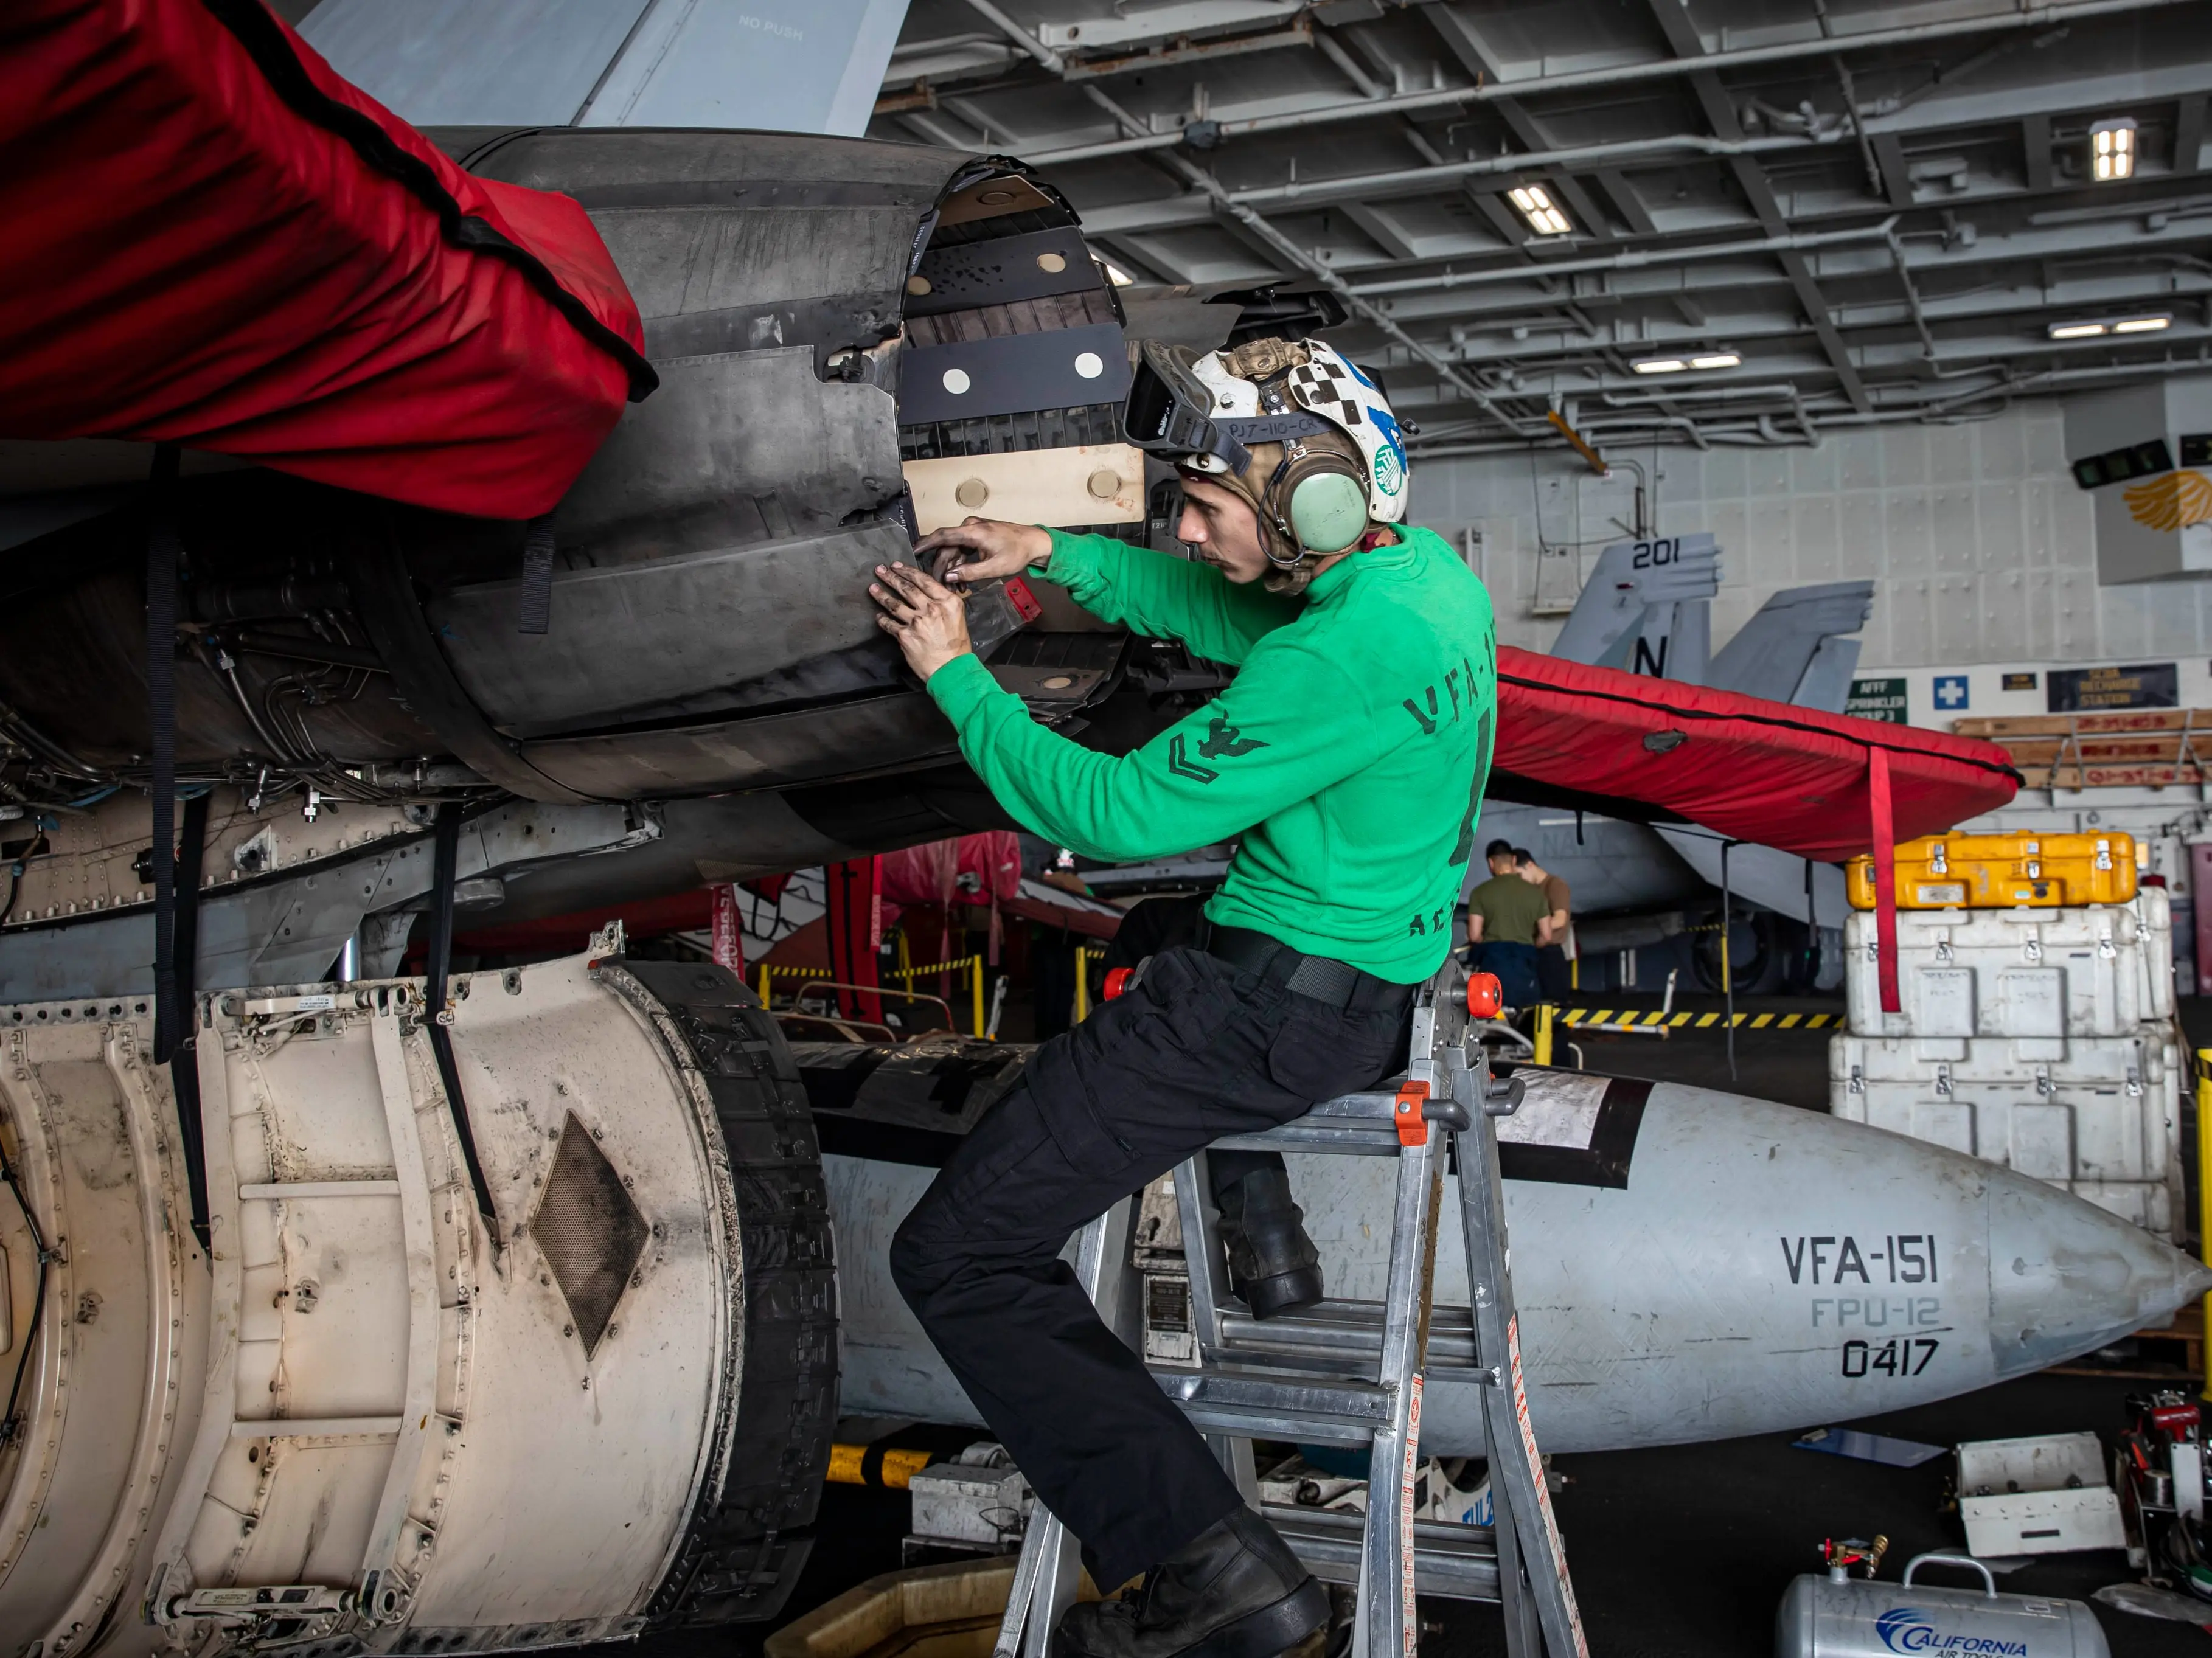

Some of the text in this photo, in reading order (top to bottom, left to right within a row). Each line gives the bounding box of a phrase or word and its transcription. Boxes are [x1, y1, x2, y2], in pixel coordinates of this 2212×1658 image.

[739, 15, 804, 41] NO PUSH
[1633, 538, 1680, 569] 201
[1634, 636, 1668, 679] N
[1781, 1235, 1938, 1285] VFA-151
[1812, 1297, 1940, 1327] FPU-12
[1842, 1339, 1941, 1378] 0417
[1902, 1626, 2027, 1657] CALIFORNIA
